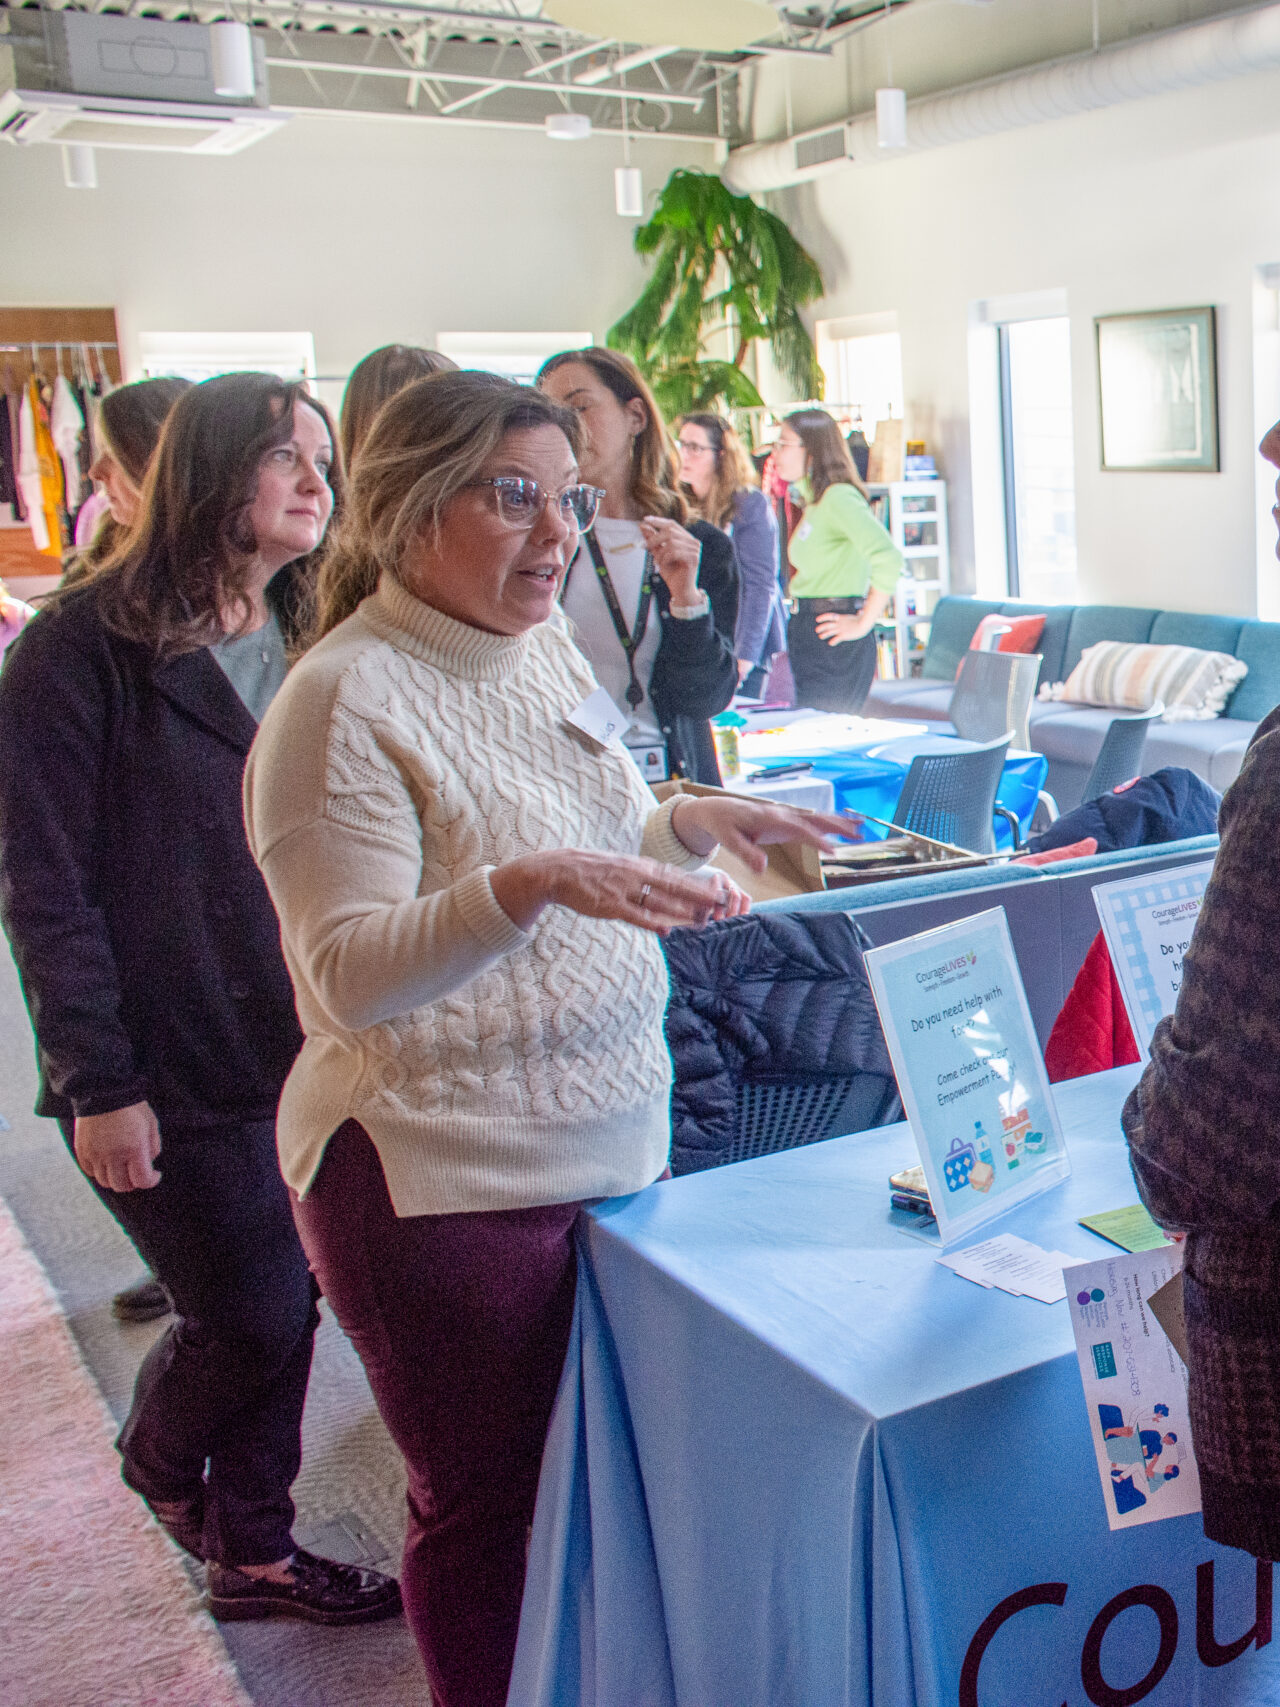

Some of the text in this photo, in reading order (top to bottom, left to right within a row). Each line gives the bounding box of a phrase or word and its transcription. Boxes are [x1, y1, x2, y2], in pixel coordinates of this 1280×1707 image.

[1152, 901, 1198, 919] CourageLIVES
[1160, 944, 1174, 956] Do
[915, 956, 967, 983] CourageLIVES
[911, 985, 1003, 1032] Do you need help with
[937, 1070, 959, 1086] Come
[960, 1058, 981, 1076] check
[937, 1074, 990, 1106] Empowerment
[1140, 1311, 1146, 1321] we
[1142, 1321, 1150, 1337] help?
